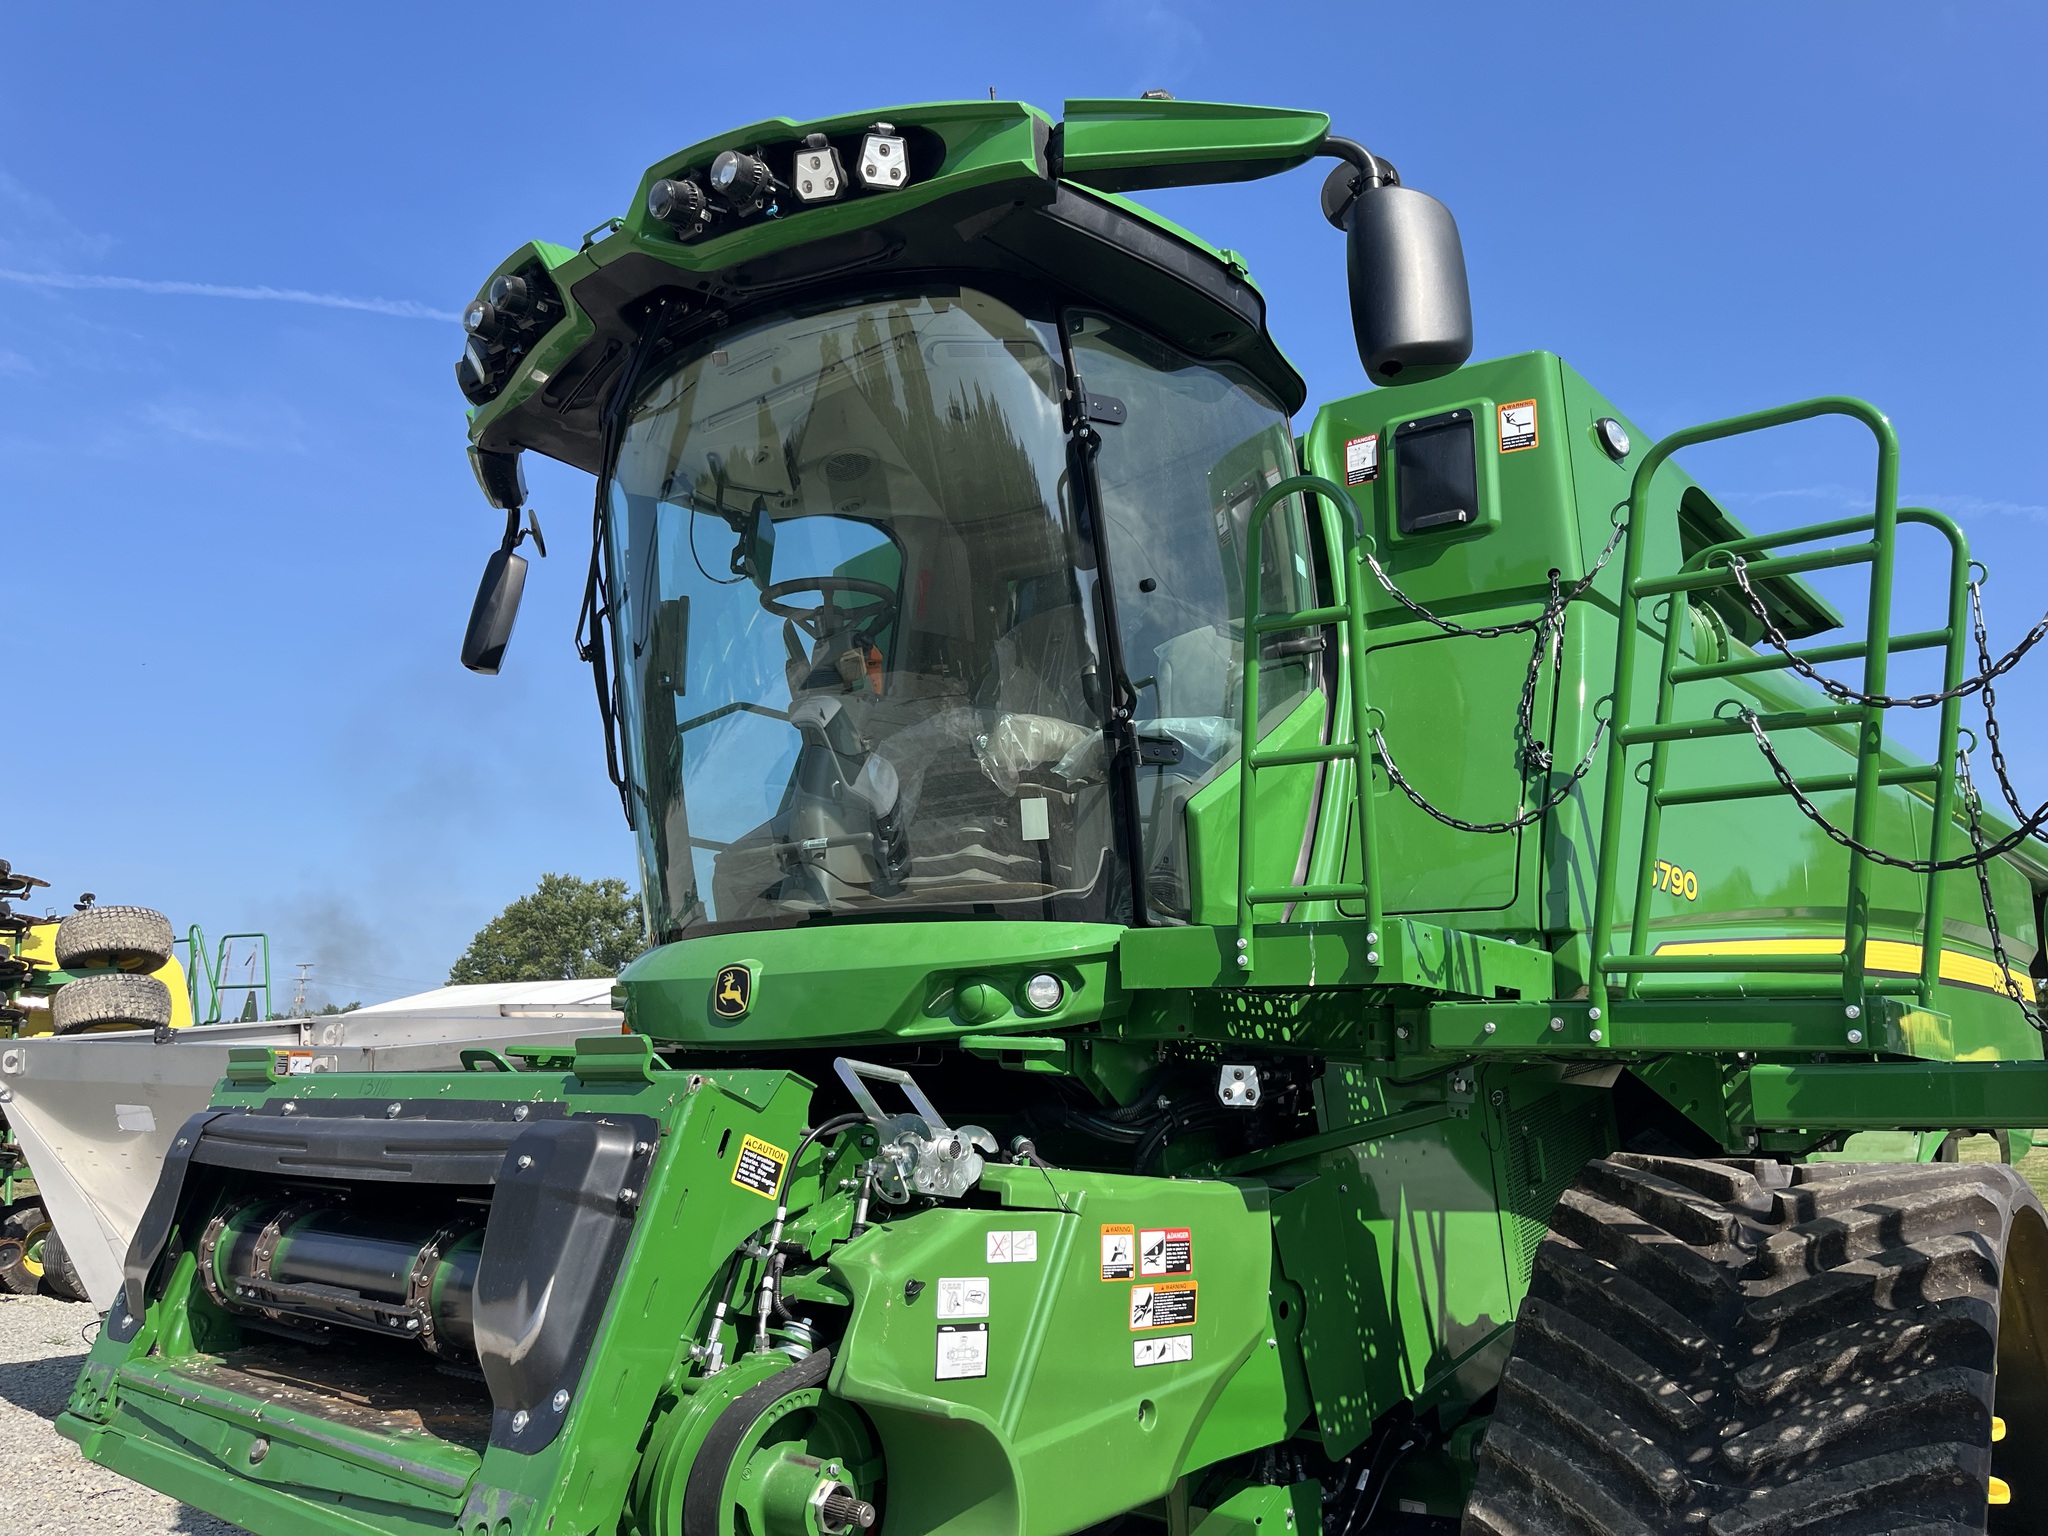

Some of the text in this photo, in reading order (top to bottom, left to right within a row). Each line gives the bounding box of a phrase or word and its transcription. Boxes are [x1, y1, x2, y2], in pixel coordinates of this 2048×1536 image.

[1507, 400, 1534, 409] WARNING
[1353, 434, 1376, 445] DANGER
[752, 1140, 786, 1161] CAUTION
[1170, 1231, 1189, 1239] DANGER
